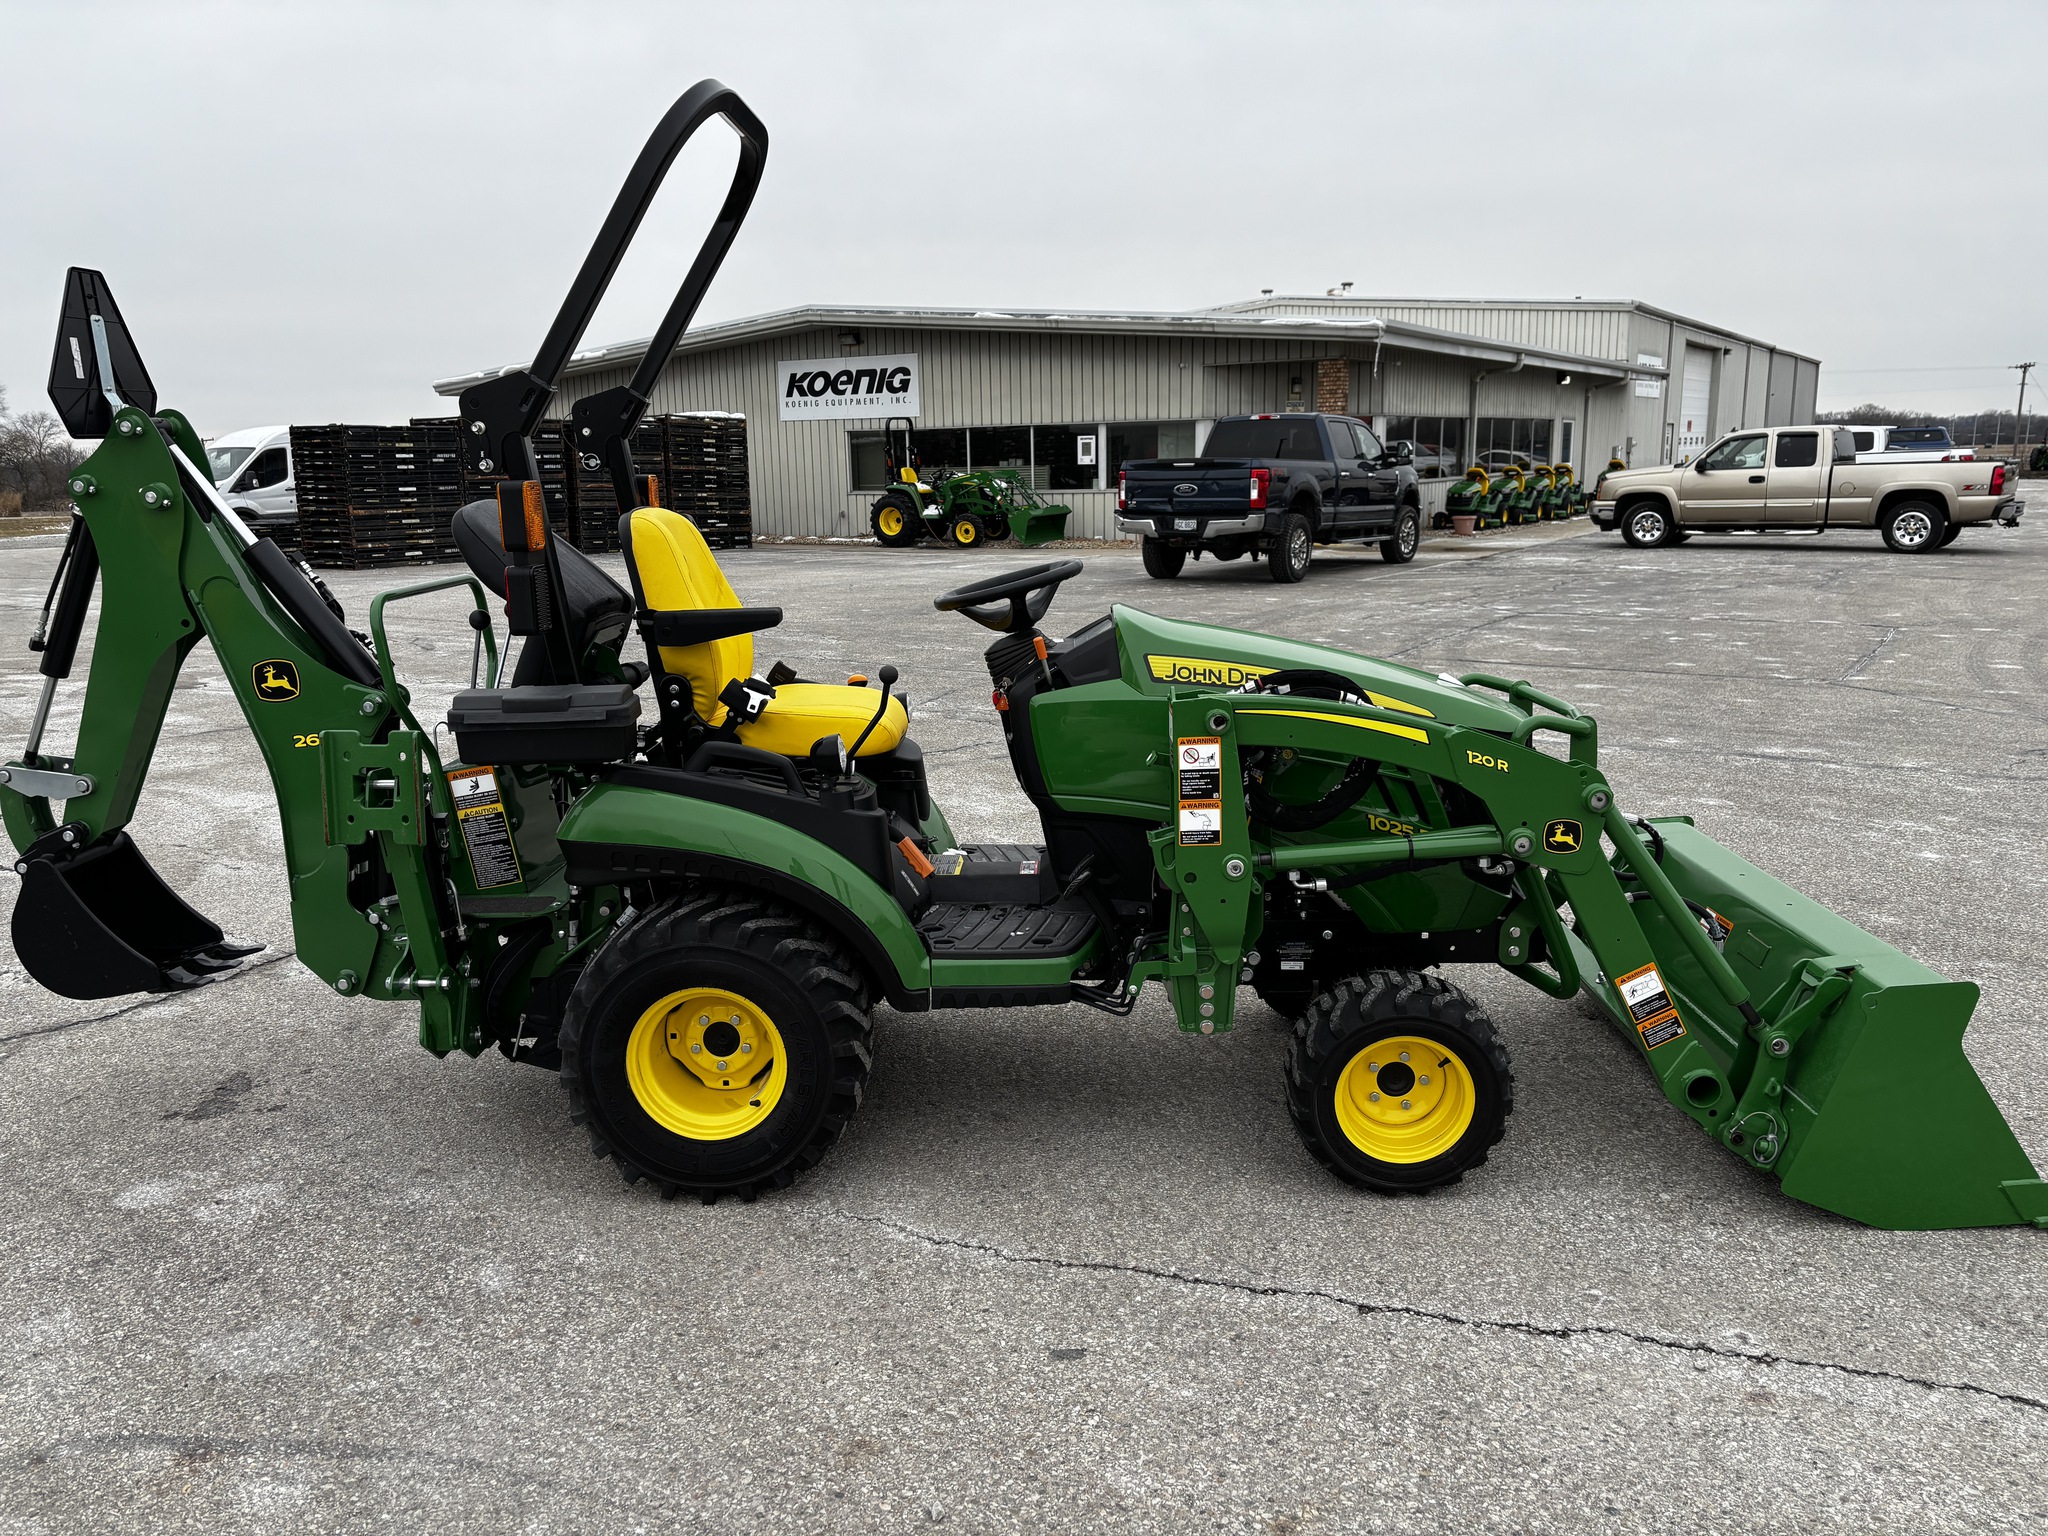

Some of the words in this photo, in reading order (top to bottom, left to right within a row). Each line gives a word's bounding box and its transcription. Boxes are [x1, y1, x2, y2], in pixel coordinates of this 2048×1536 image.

[785, 399, 820, 408] KOENIG
[825, 397, 884, 407] EQUIPMENT,
[890, 396, 912, 404] INC.
[1164, 663, 1222, 683] JOHN
[1228, 668, 1265, 684] DE
[1466, 749, 1495, 768] 120
[1497, 758, 1510, 773] R
[457, 768, 489, 779] WARNING
[469, 806, 498, 817] CAUTION
[1368, 813, 1414, 836] 1025
[1626, 966, 1651, 980] WARNING
[1648, 1012, 1674, 1026] WARNING
